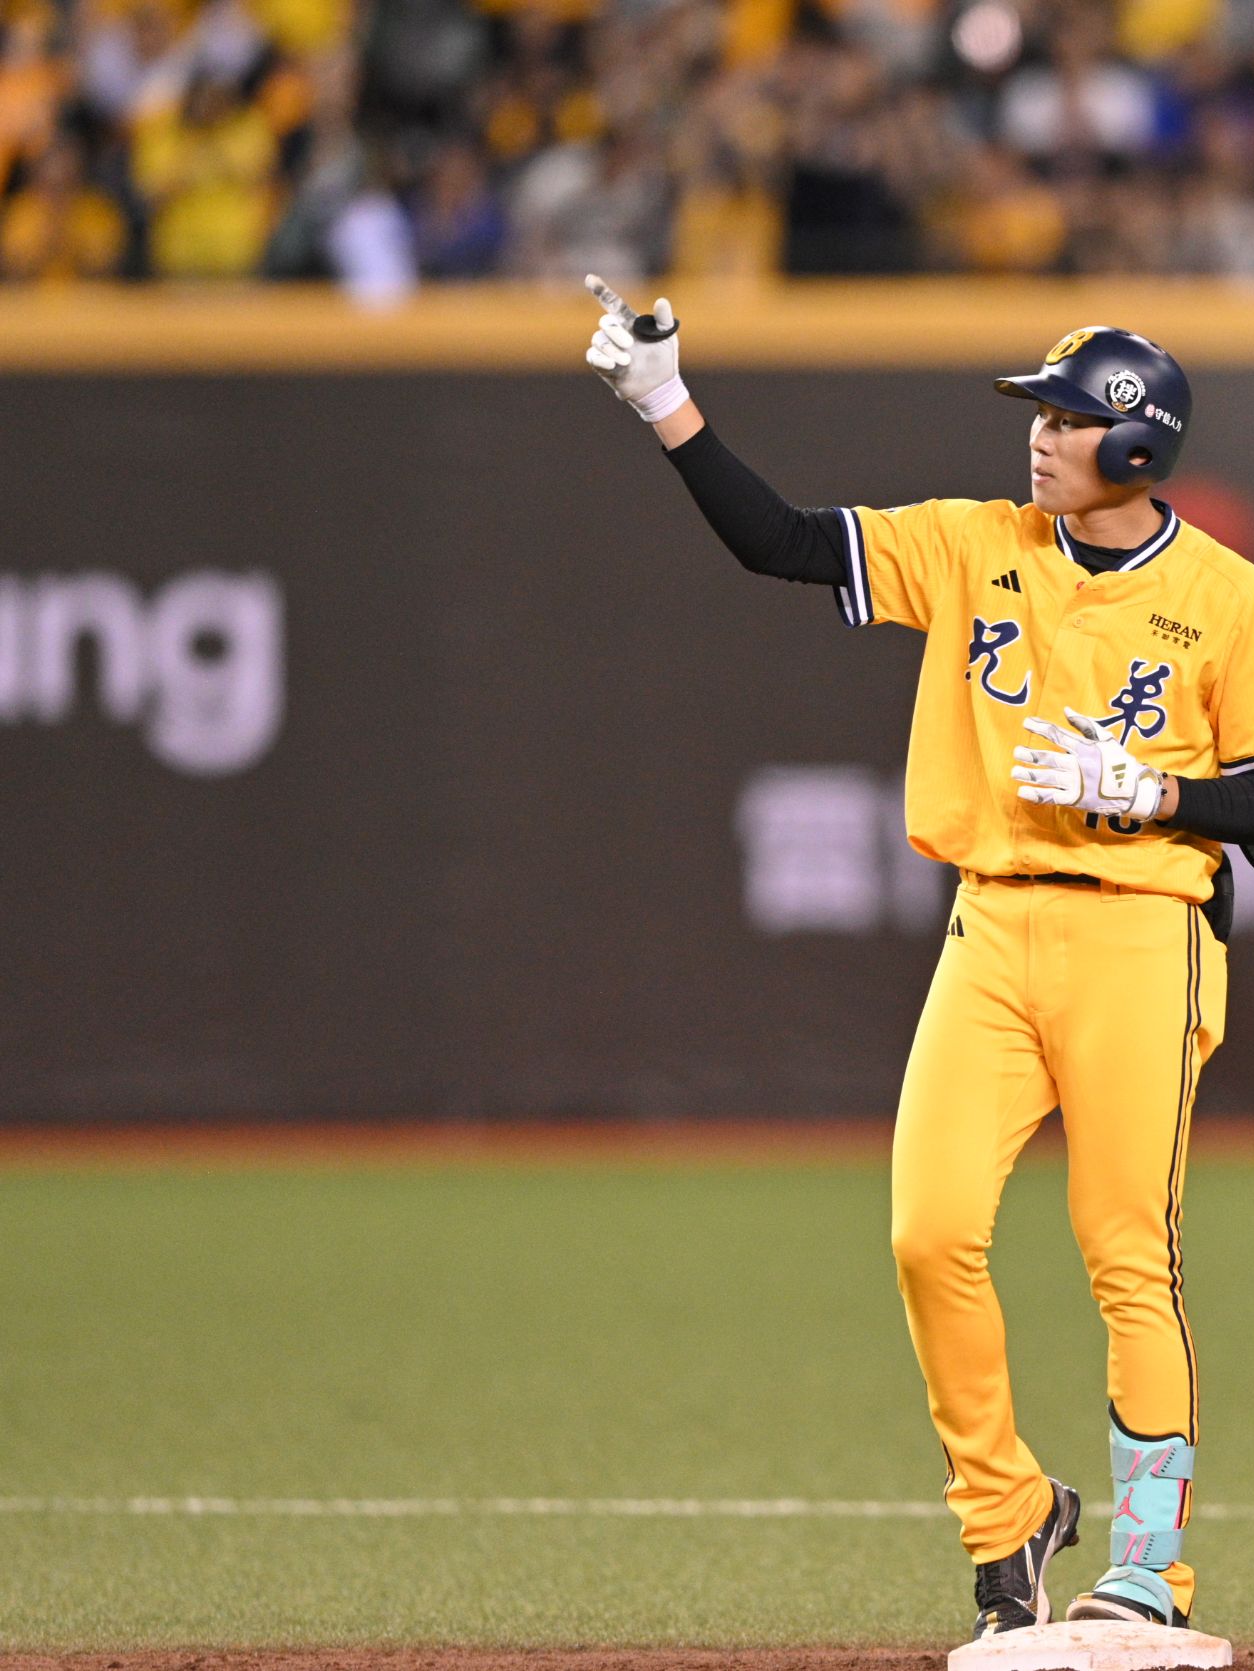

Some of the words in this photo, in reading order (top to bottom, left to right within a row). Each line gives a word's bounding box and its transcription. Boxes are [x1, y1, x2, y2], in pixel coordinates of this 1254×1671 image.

[1155, 407, 1183, 433] 守信人力
[1148, 613, 1202, 642] HERAN
